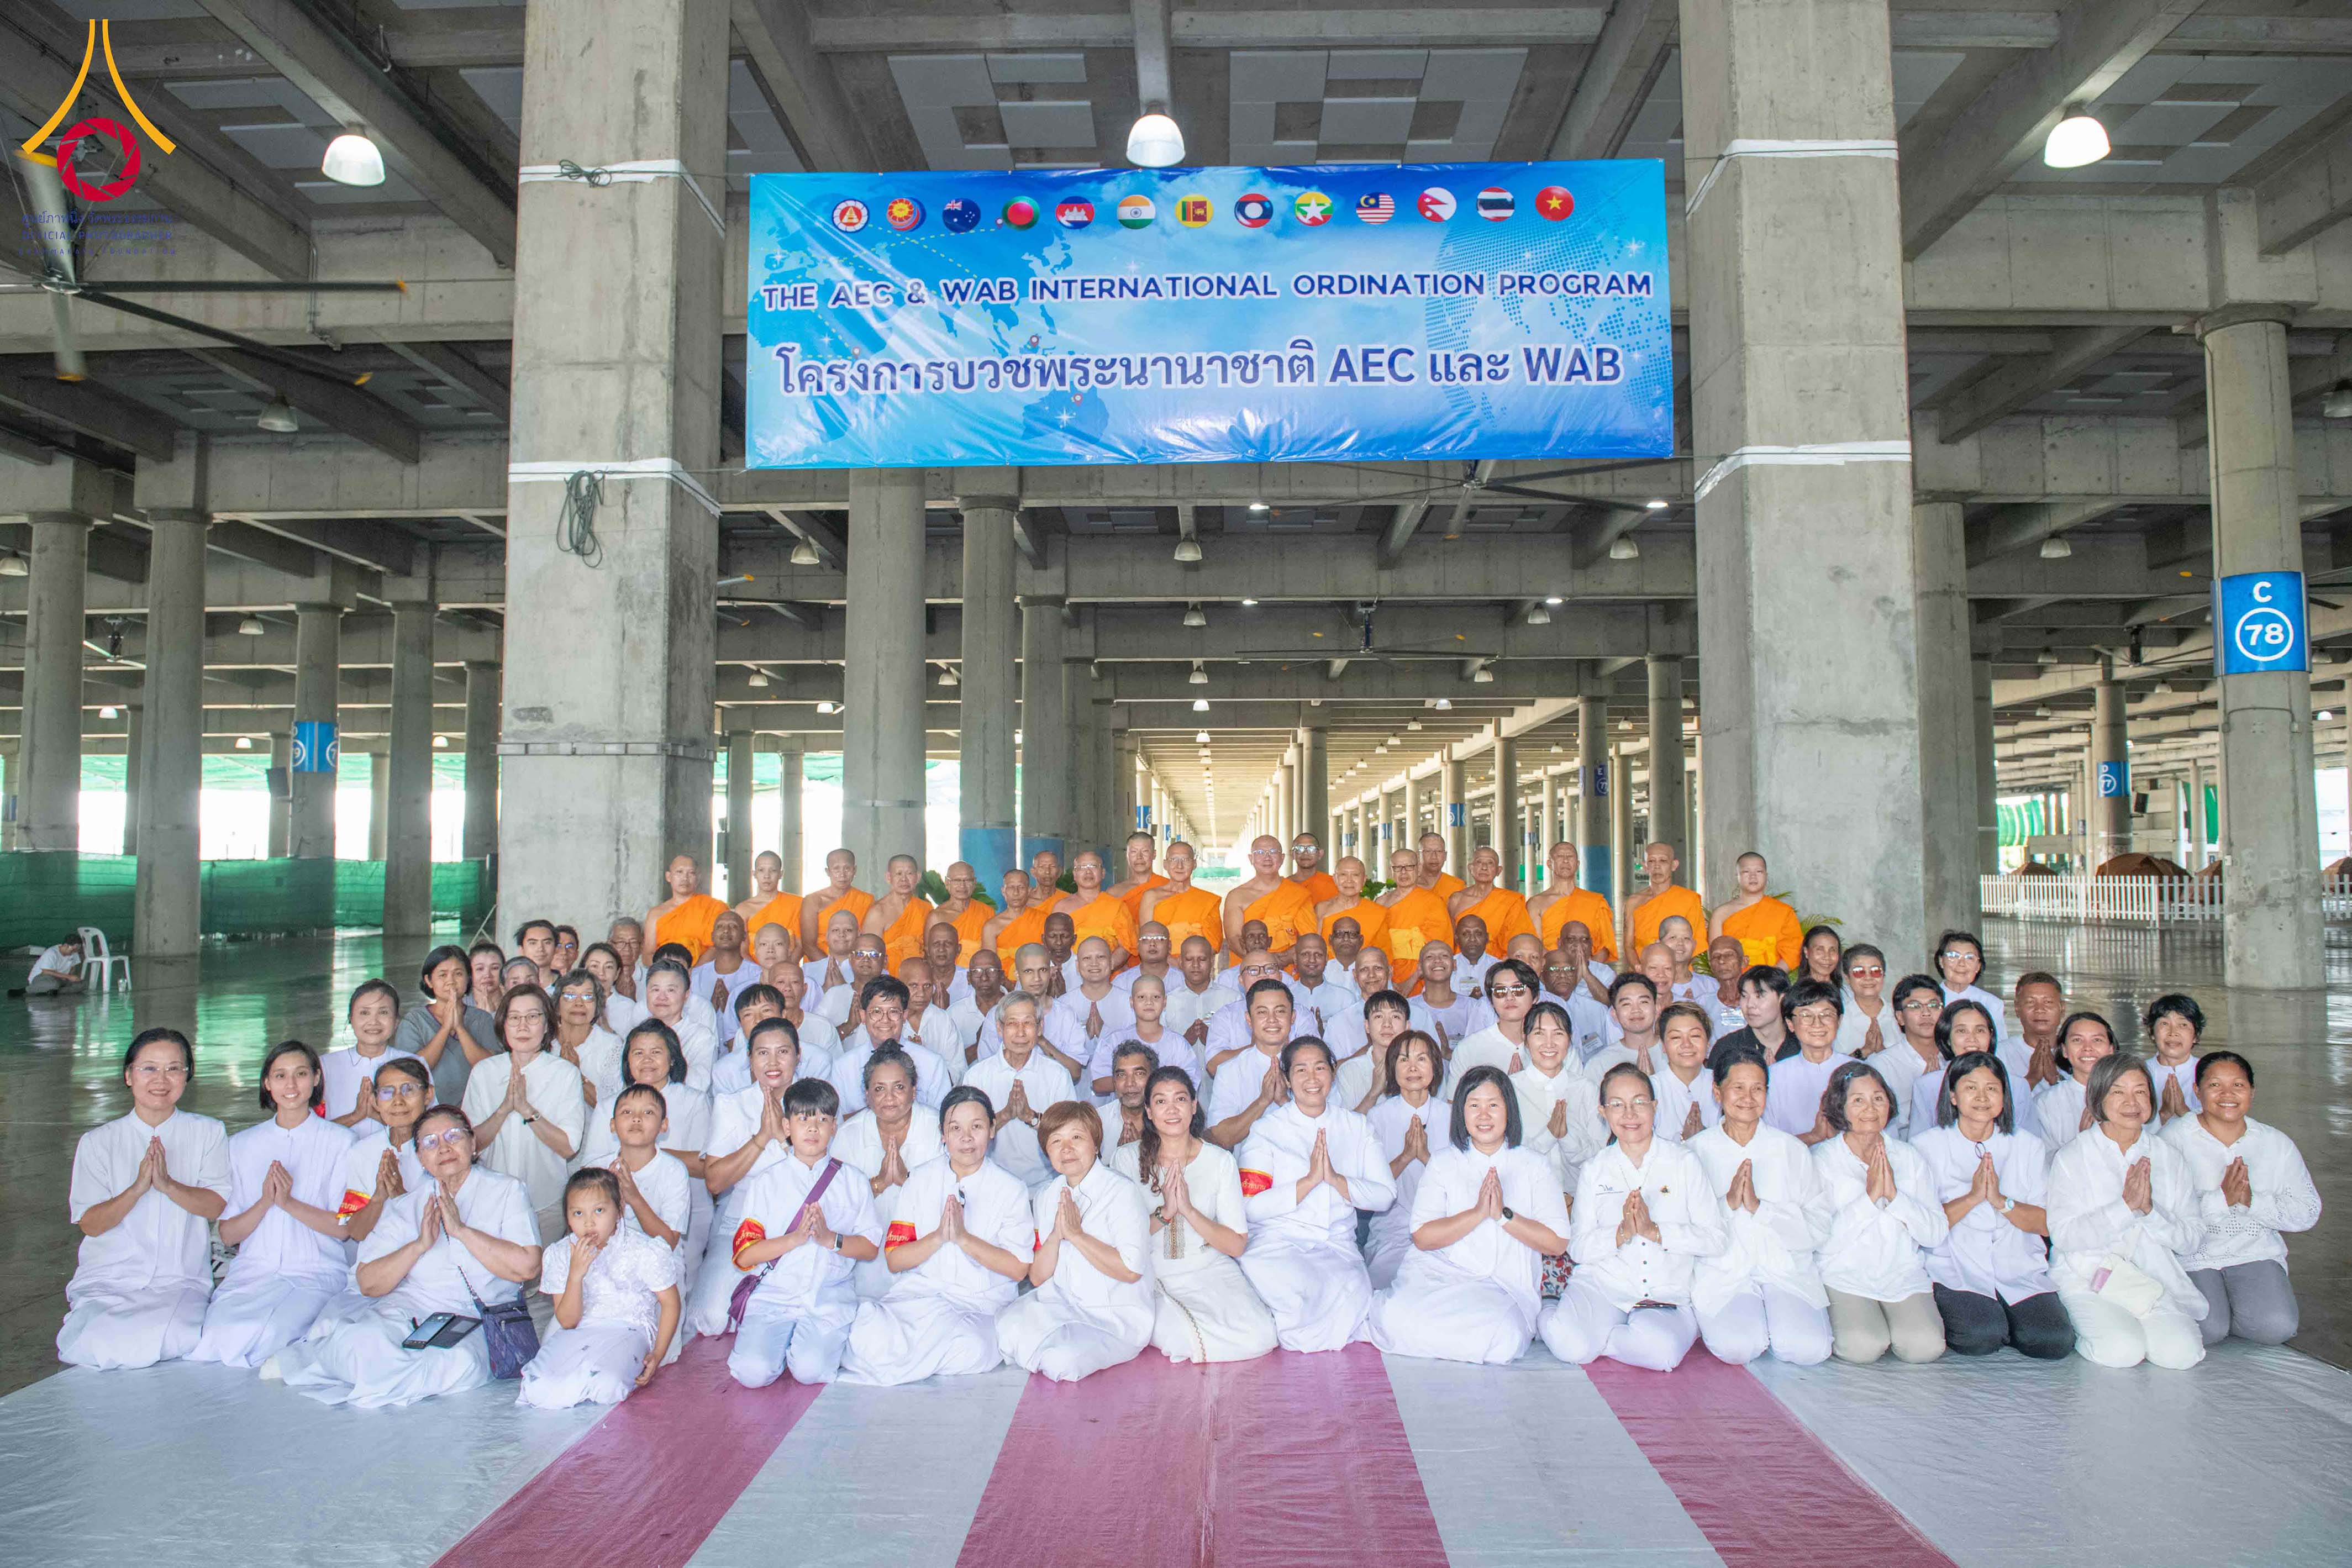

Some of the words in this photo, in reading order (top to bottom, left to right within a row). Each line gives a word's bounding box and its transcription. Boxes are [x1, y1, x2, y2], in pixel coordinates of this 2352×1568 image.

[764, 285, 815, 308] THE
[831, 284, 892, 306] AEC
[907, 282, 927, 304] &
[943, 280, 1017, 303] WAB
[1032, 275, 1277, 301] INTERNATIONAL
[1293, 274, 1485, 295] ORDINATION
[1500, 273, 1652, 295] PROGRAM
[776, 339, 1314, 393] โครงการบวชพระนานาชาติ
[1329, 348, 1415, 382] AEC
[1429, 351, 1510, 382] และ
[1523, 348, 1621, 382] WAB
[2253, 581, 2272, 603] C
[2245, 623, 2285, 646] 78
